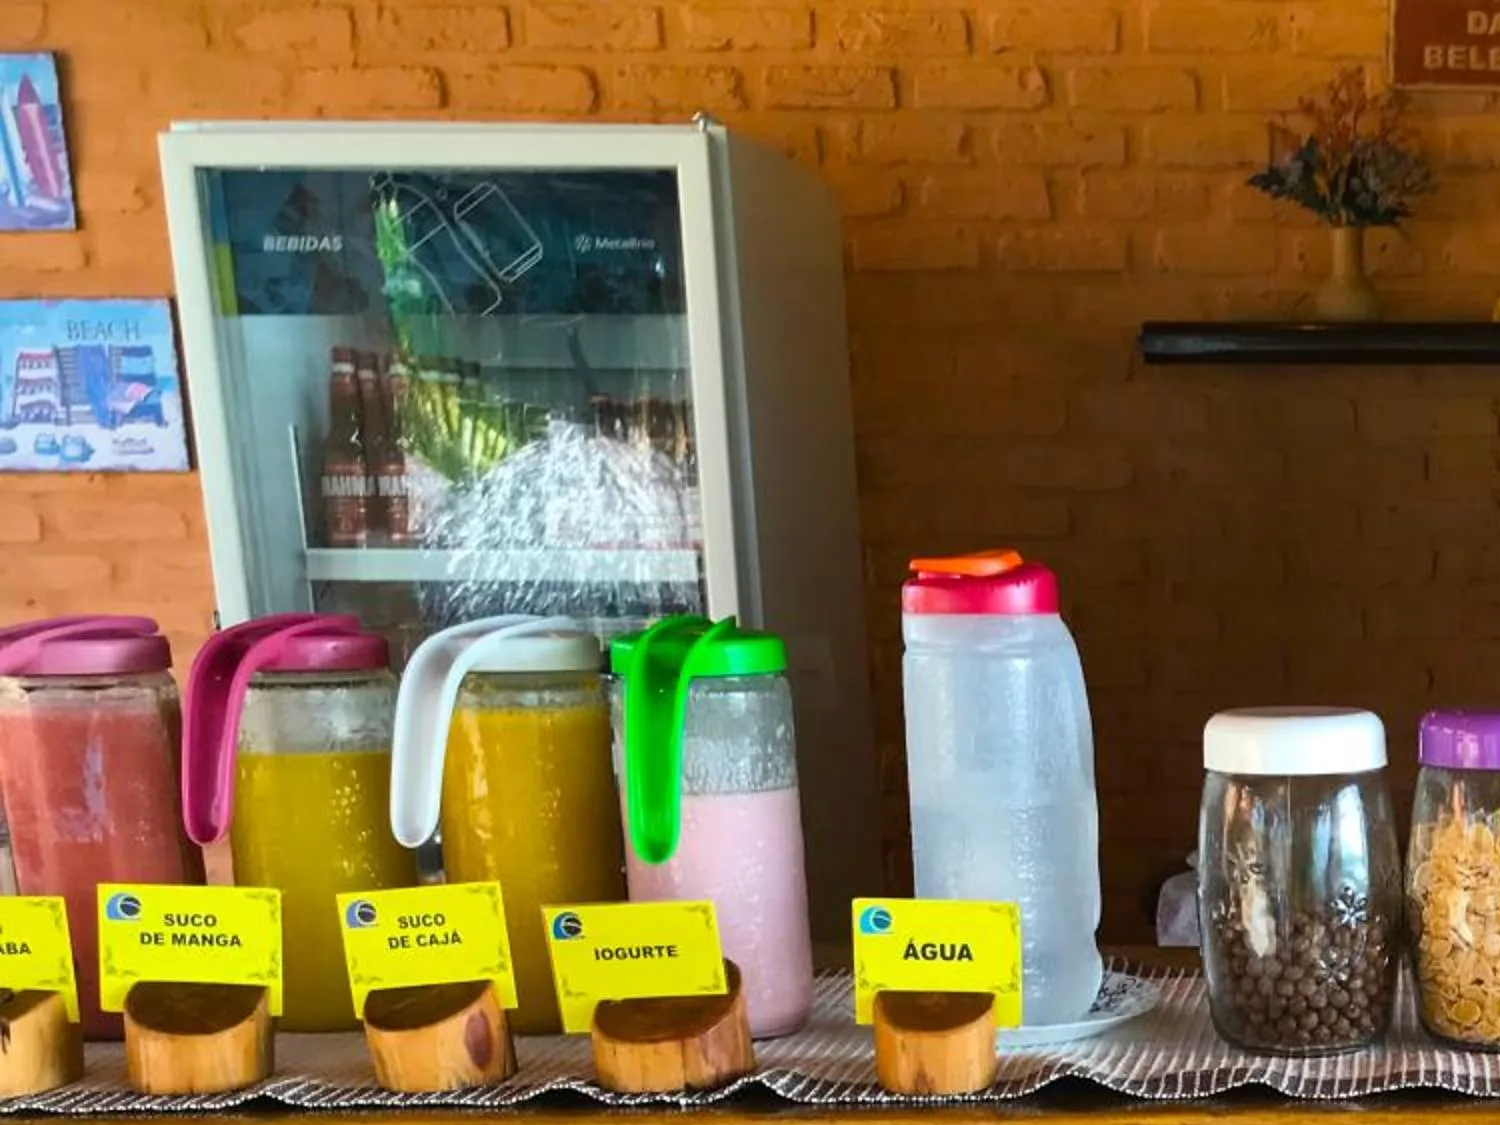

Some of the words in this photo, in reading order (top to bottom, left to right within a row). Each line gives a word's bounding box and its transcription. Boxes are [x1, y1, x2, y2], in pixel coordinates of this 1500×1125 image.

[263, 235, 343, 252] BEBIDAS
[66, 318, 141, 341] BEACH
[163, 913, 217, 927] SUCO
[397, 913, 446, 929] SUCO
[139, 932, 165, 946] DE
[171, 933, 242, 948] MANGA
[388, 935, 410, 949] DE
[415, 928, 462, 947] CAJÁ
[594, 944, 680, 961] IOGURTE
[903, 937, 974, 962] ÁGUA
